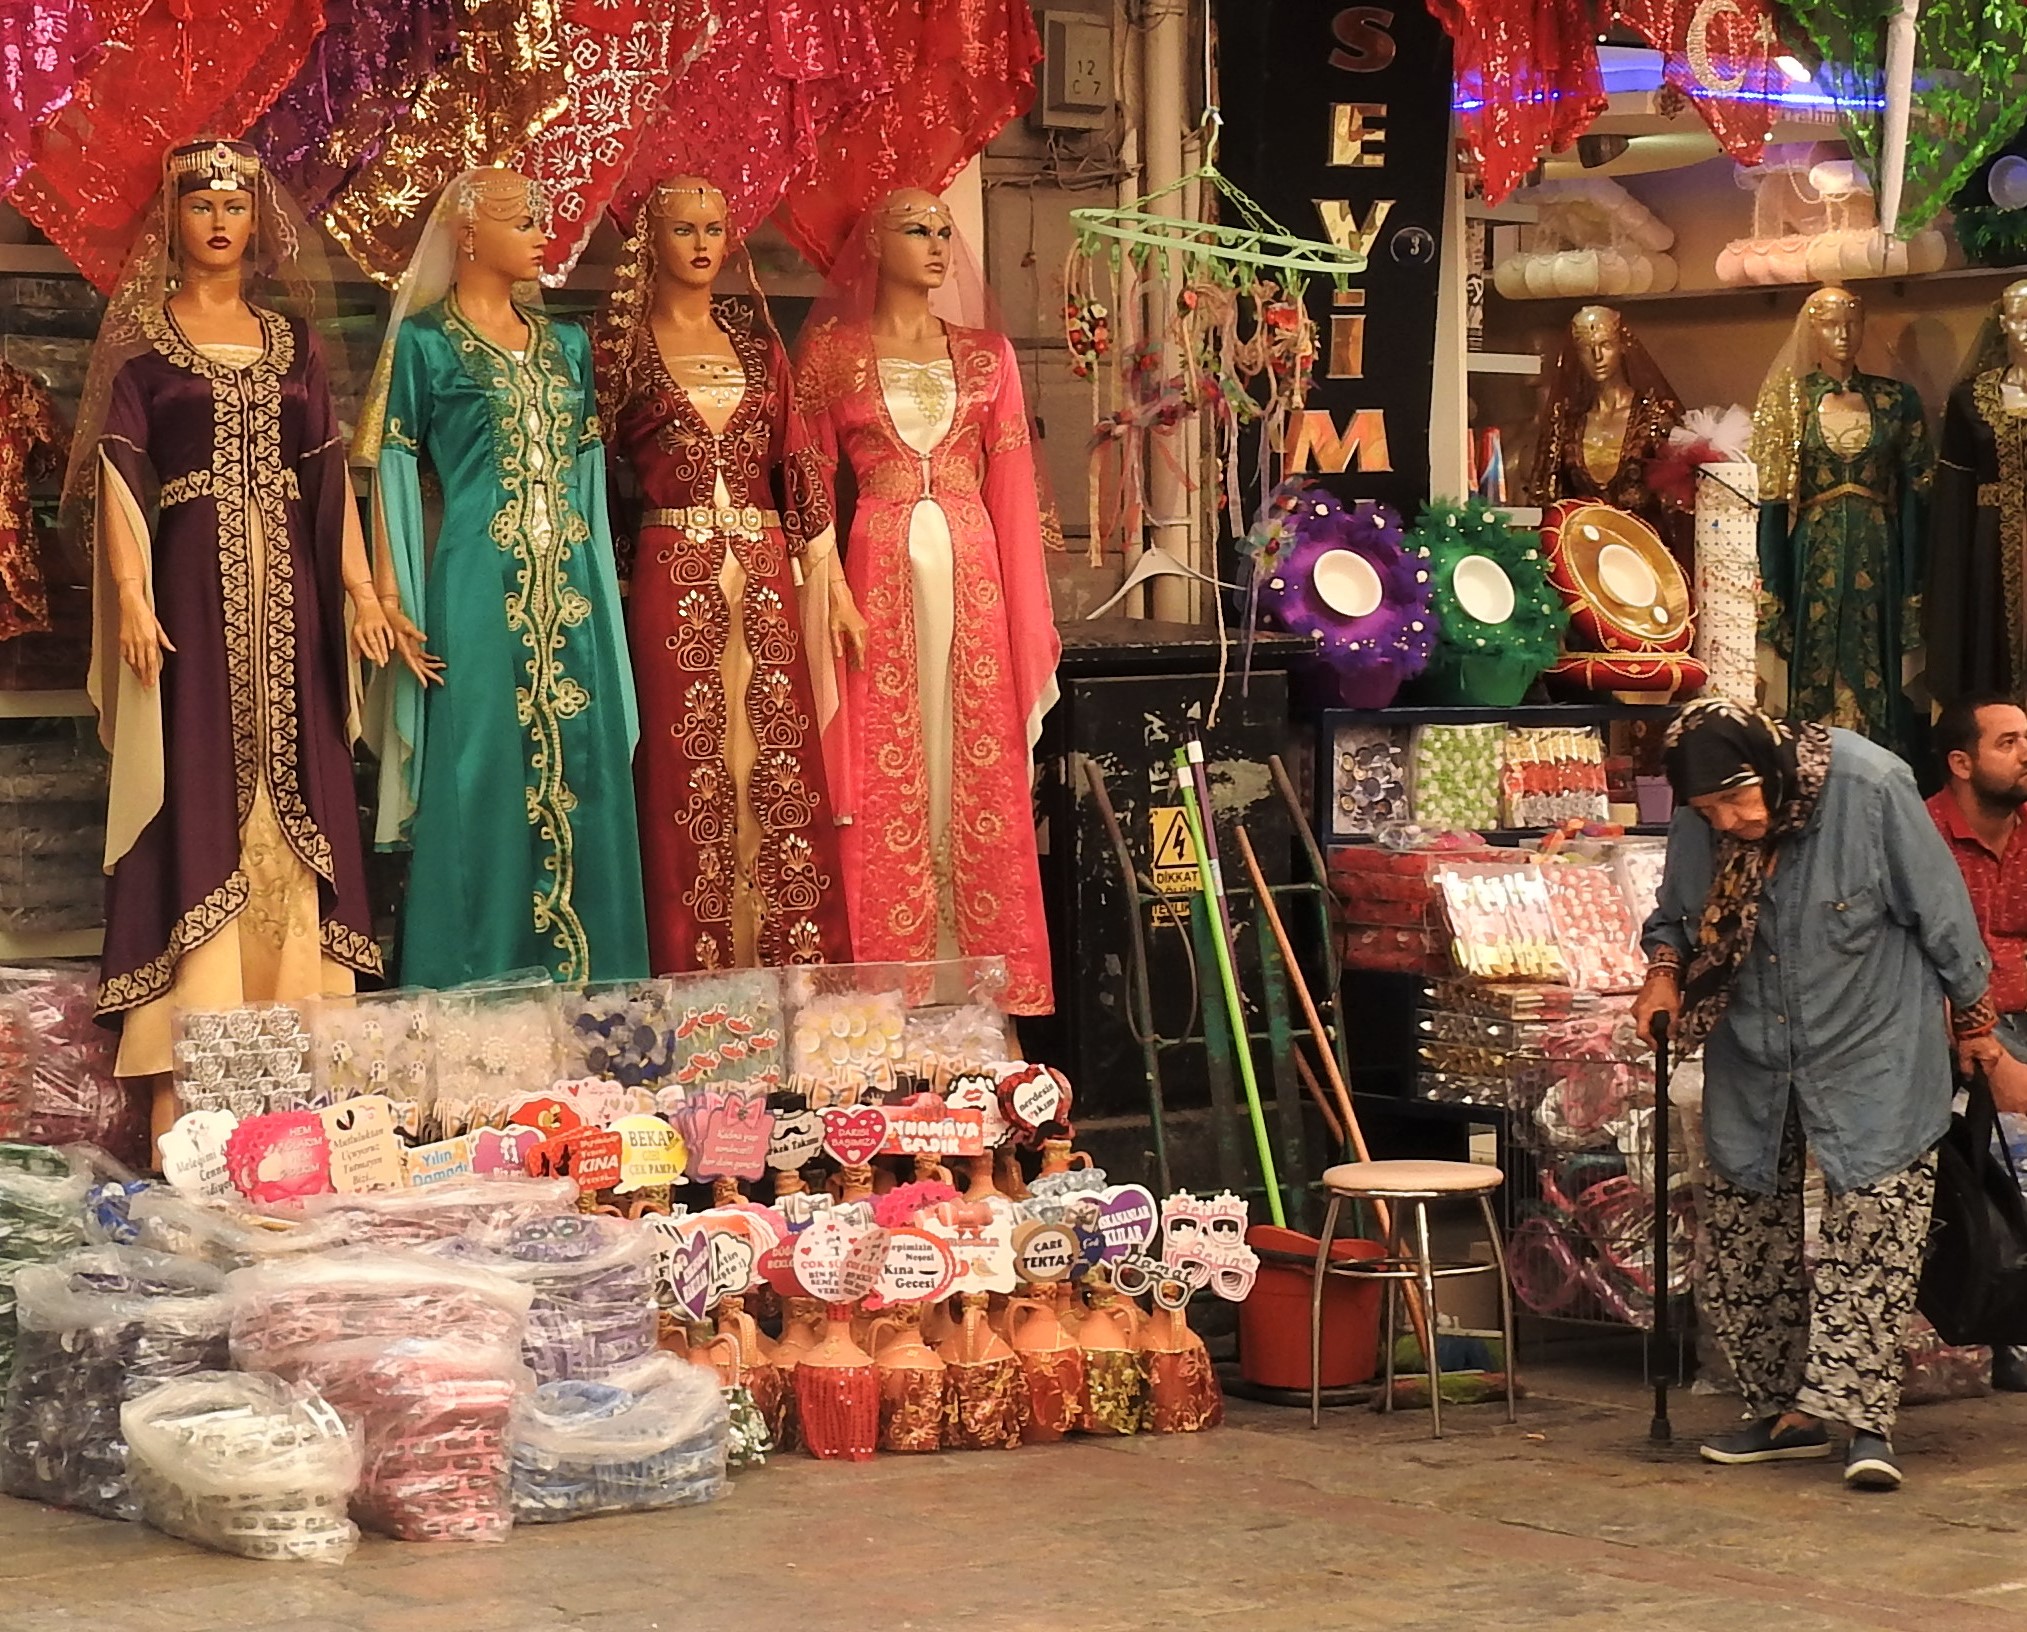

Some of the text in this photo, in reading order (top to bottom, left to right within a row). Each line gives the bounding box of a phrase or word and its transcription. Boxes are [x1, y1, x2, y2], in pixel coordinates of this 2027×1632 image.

[578, 1154, 619, 1174] KINA
[884, 1264, 914, 1275] Kına
[895, 1277, 935, 1289] Gecesi
